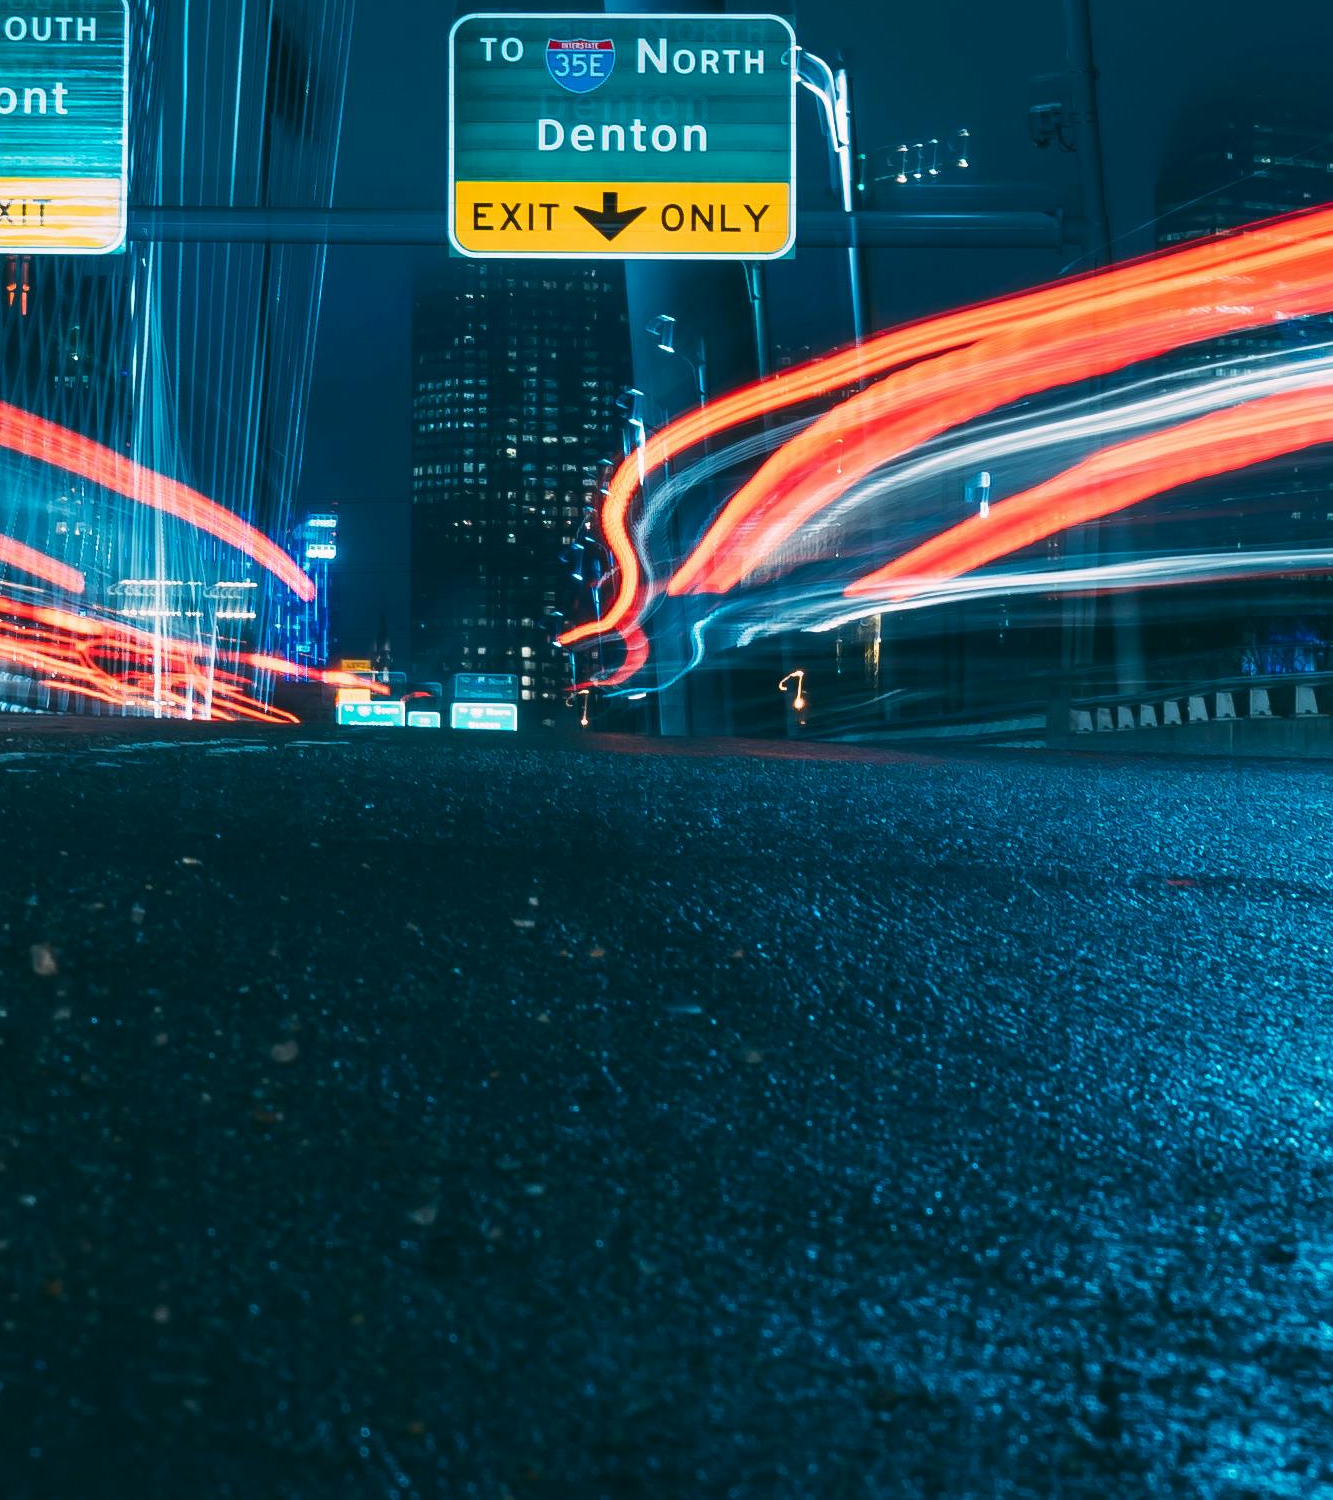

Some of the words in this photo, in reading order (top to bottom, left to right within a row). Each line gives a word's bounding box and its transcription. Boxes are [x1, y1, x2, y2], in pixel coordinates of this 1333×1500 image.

[479, 37, 525, 62] TO
[554, 52, 605, 77] 35E
[636, 37, 765, 75] NORTH
[561, 42, 599, 50] INTERSTATE
[537, 118, 708, 153] Denton
[473, 203, 560, 231] EXIT
[660, 203, 771, 233] ONLY
